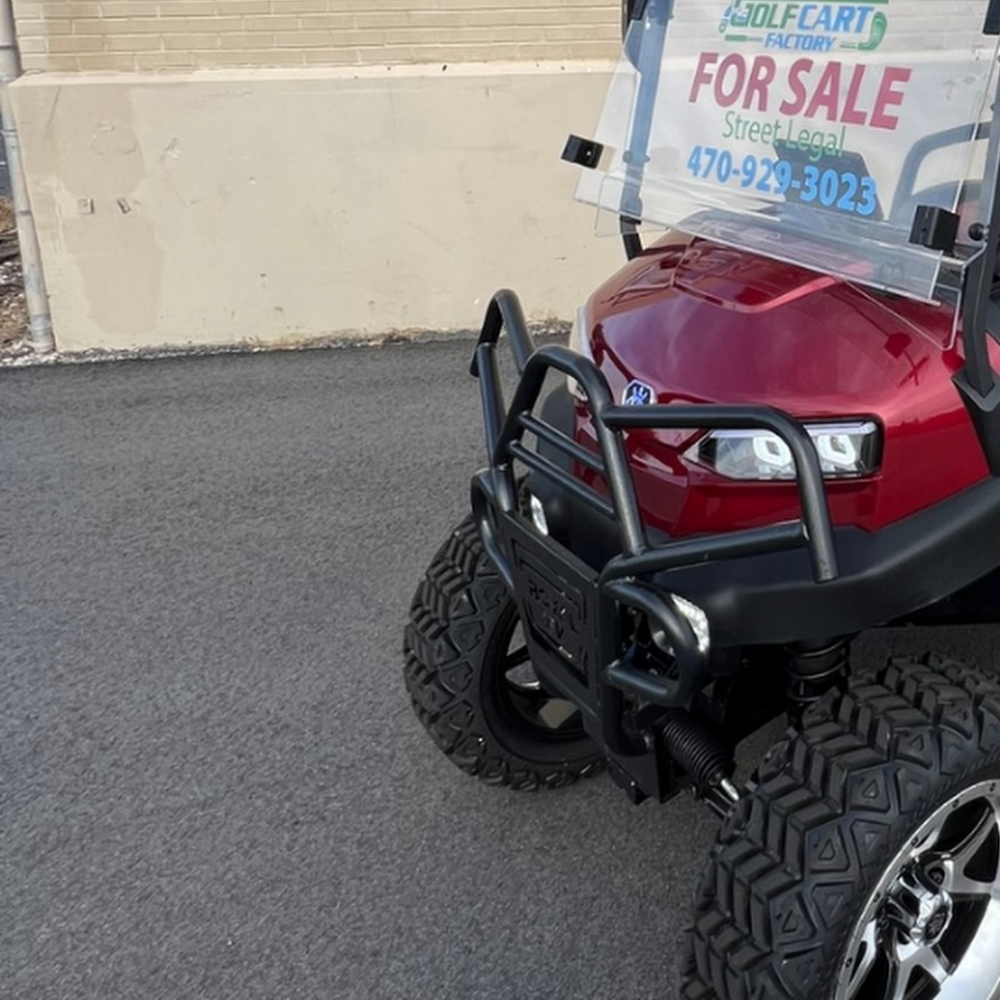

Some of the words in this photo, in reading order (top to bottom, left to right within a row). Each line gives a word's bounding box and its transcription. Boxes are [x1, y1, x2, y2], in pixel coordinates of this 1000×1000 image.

[763, 32, 837, 53] FACTORY
[688, 52, 777, 113] FOR
[779, 57, 913, 131] SALE
[721, 110, 781, 146] Street
[785, 118, 847, 162] Legal
[686, 145, 878, 216] 470-929-3023
